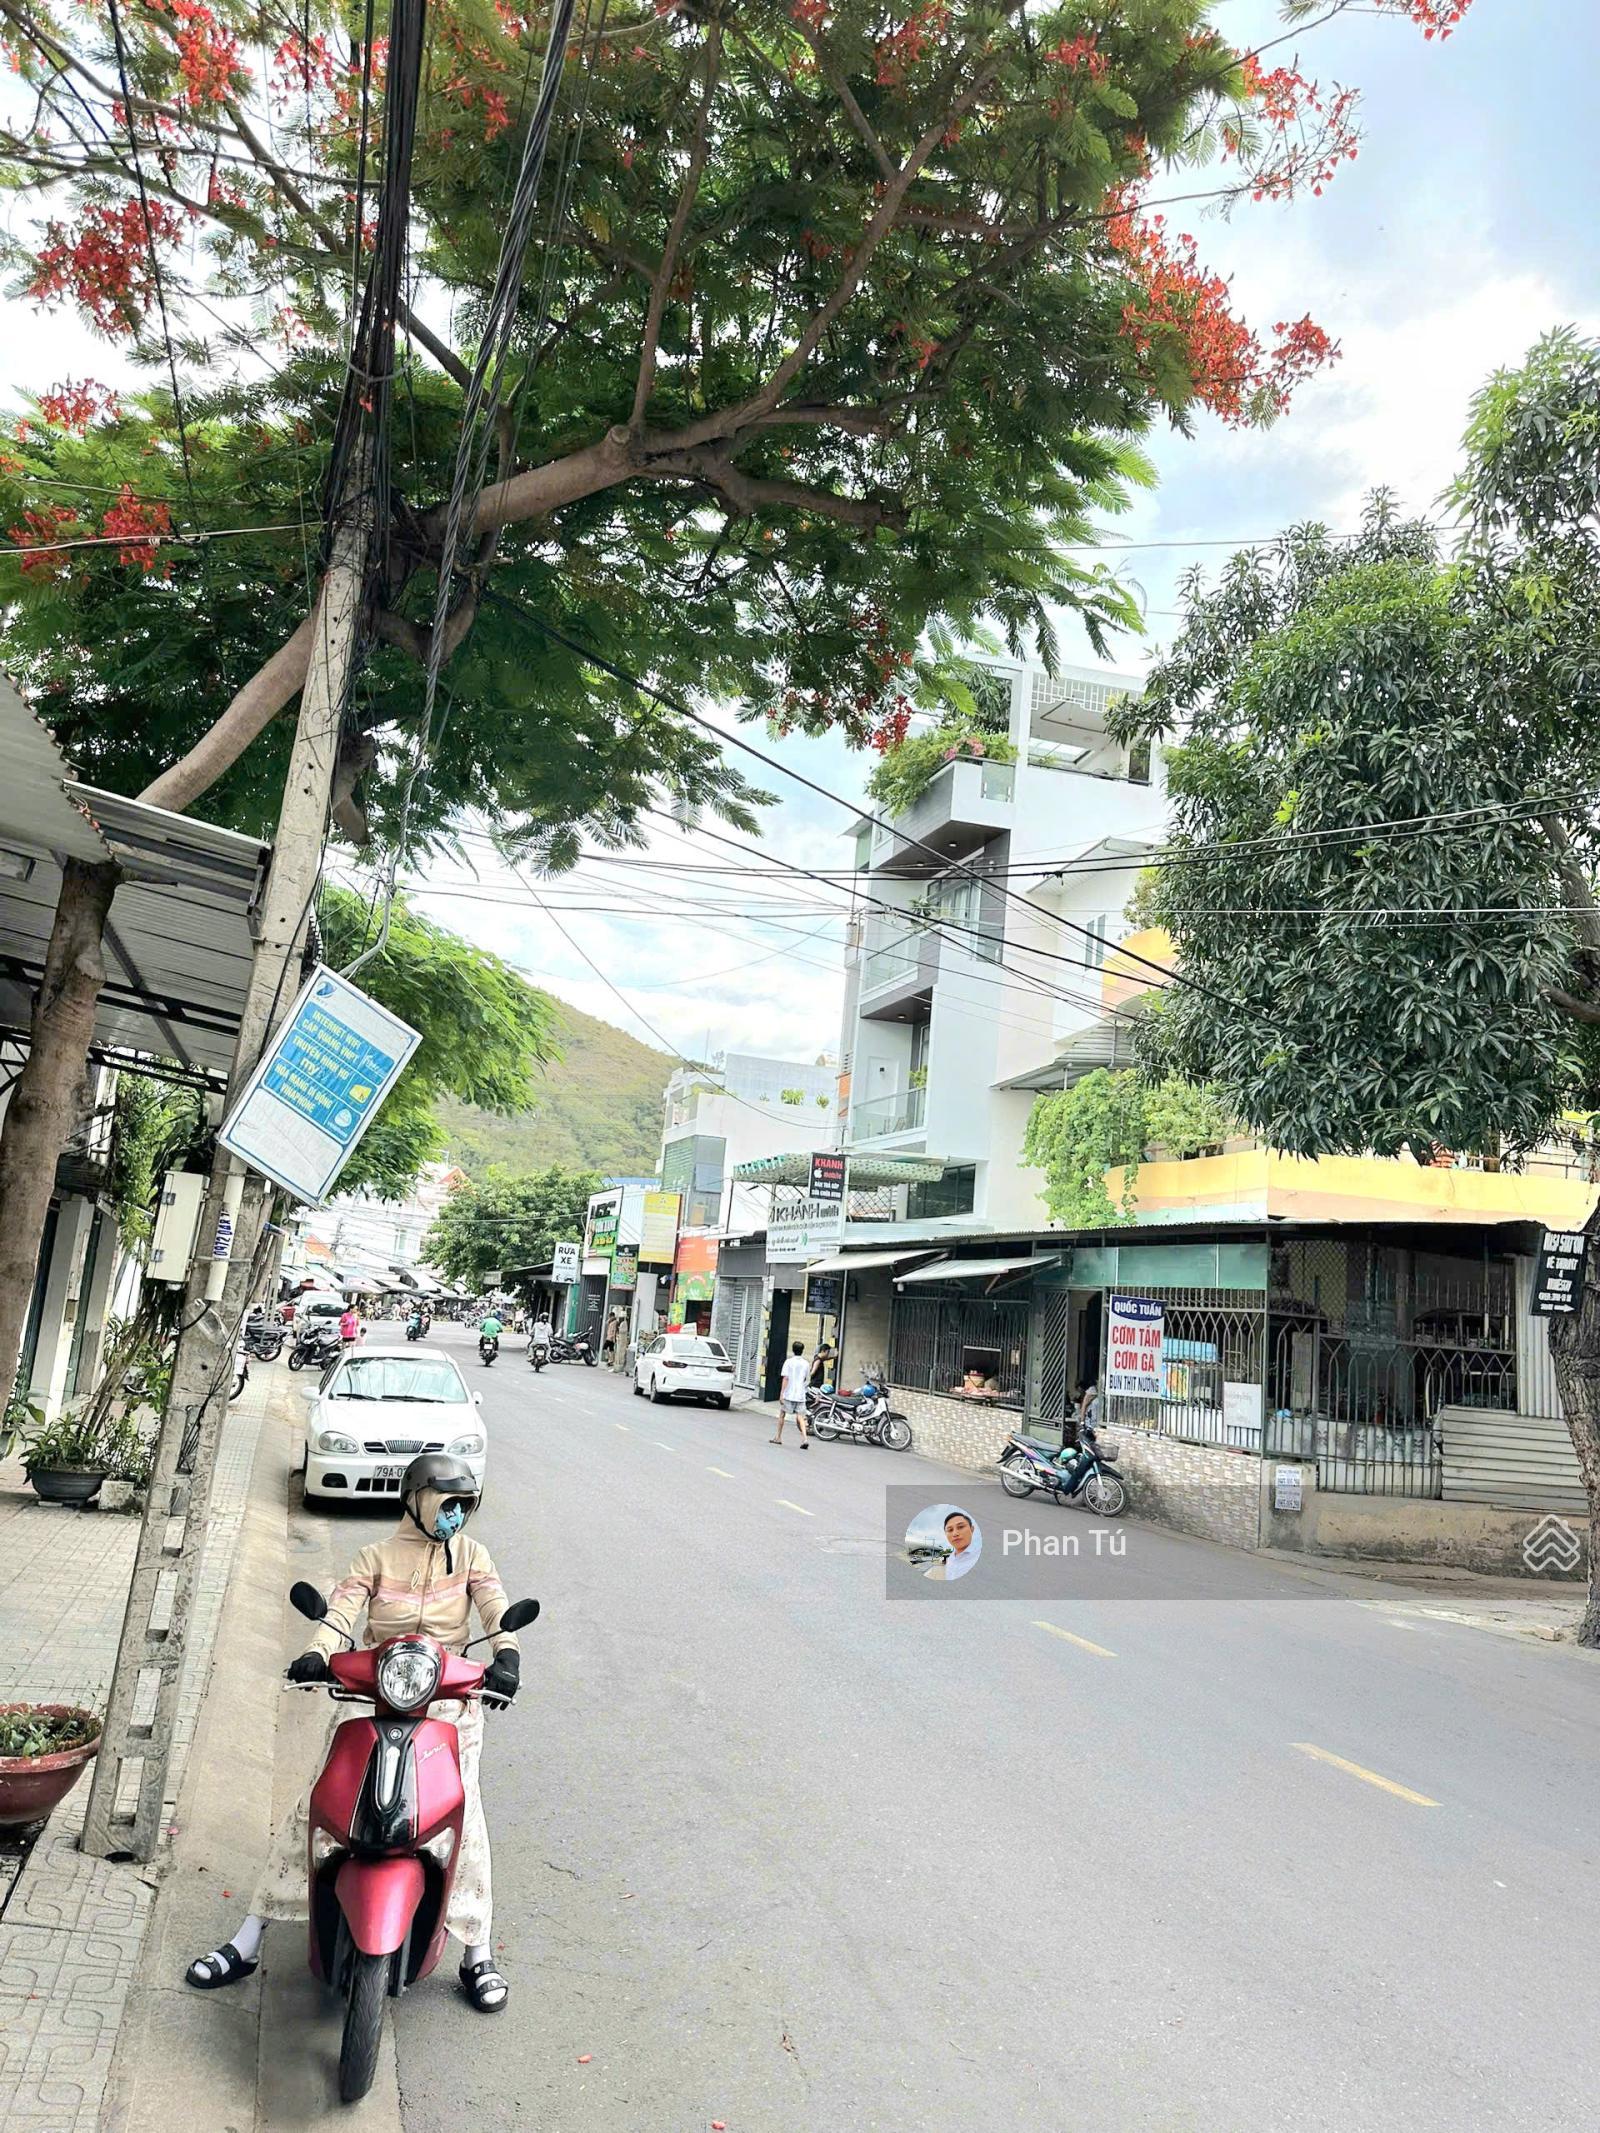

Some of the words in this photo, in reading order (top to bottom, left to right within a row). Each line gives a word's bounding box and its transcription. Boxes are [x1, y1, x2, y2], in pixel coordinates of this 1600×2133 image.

[312, 1011, 346, 1038] INTERNET
[776, 1198, 820, 1222] KHÁNH
[560, 1257, 573, 1265] XE
[1114, 1300, 1138, 1314] QUỐC
[1112, 1325, 1136, 1345] CƠM
[1139, 1323, 1161, 1348] TẤM
[1114, 1349, 1138, 1370] CƠM
[1141, 1351, 1155, 1372] GÀ
[1109, 1372, 1122, 1389] BÚN
[376, 1466, 407, 1478] 79A-0
